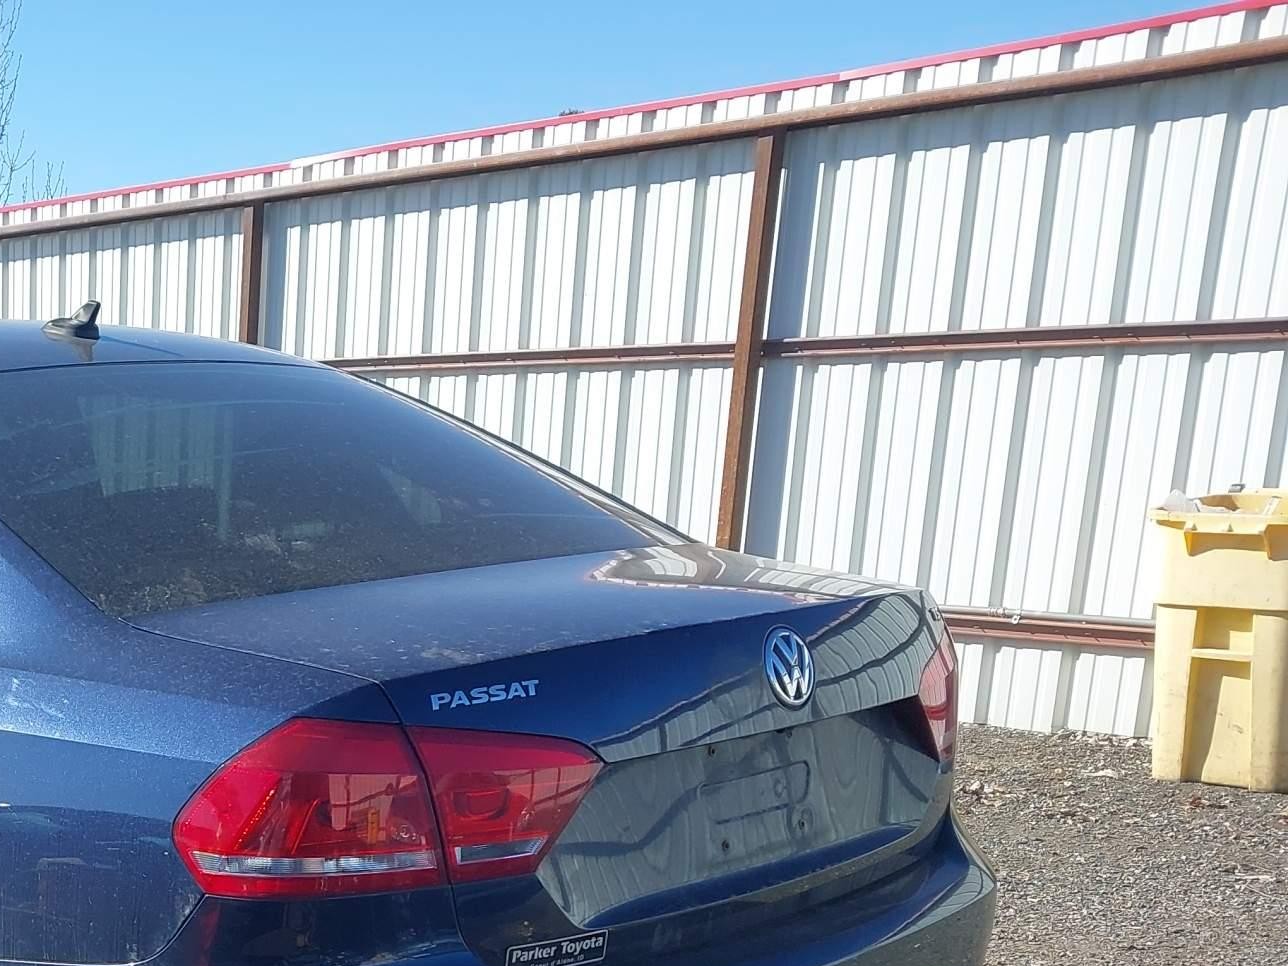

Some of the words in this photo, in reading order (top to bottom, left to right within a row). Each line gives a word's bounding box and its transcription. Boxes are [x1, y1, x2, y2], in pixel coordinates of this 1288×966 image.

[430, 680, 540, 711] PASSAT
[511, 946, 557, 963] Parker
[560, 936, 604, 955] Toyota
